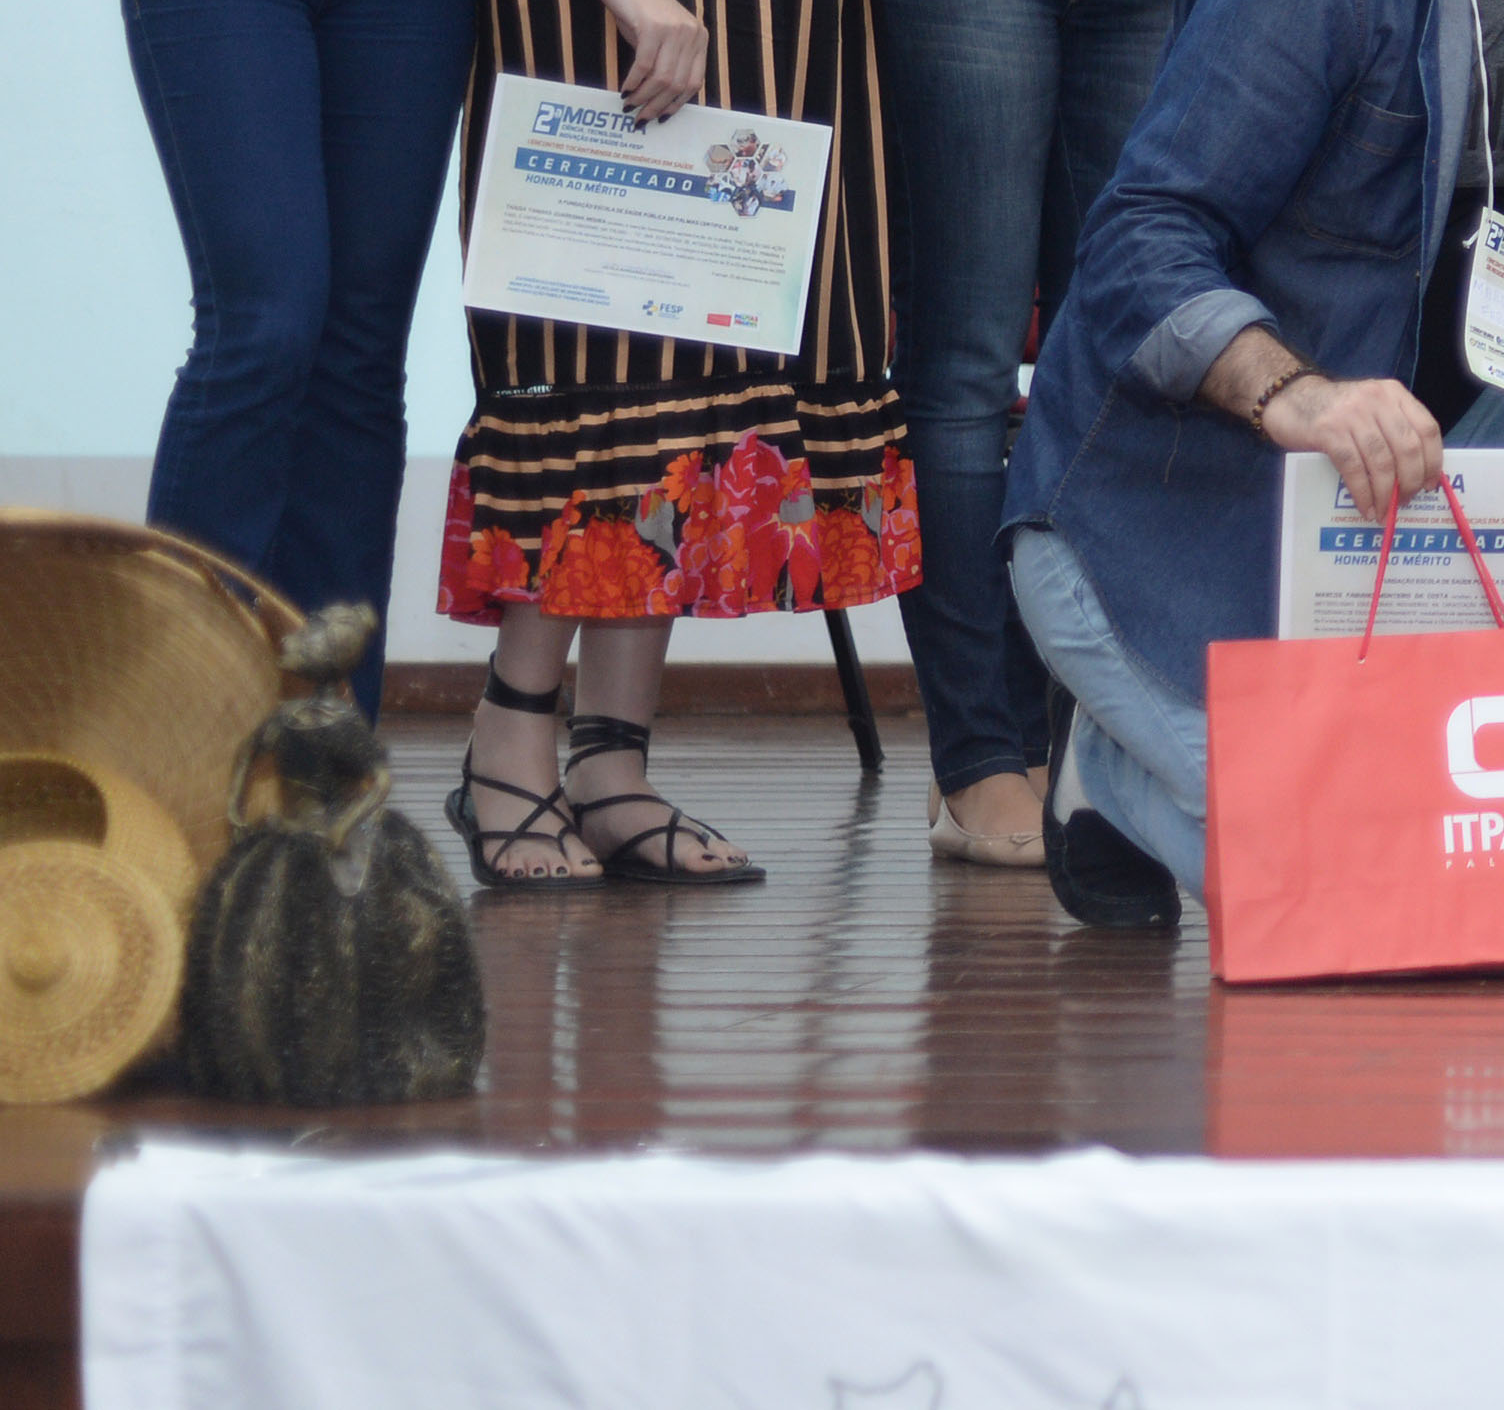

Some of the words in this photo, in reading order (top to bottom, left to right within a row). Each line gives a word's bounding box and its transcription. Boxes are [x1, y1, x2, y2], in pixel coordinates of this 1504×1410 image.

[527, 154, 693, 191] CERTIFICADO
[525, 173, 563, 187] HONRA
[565, 179, 582, 190] AO
[583, 181, 627, 198] MÉRITO
[659, 303, 684, 315] FESP
[1334, 555, 1378, 565] HONRA
[1402, 553, 1451, 566] MÉRITO
